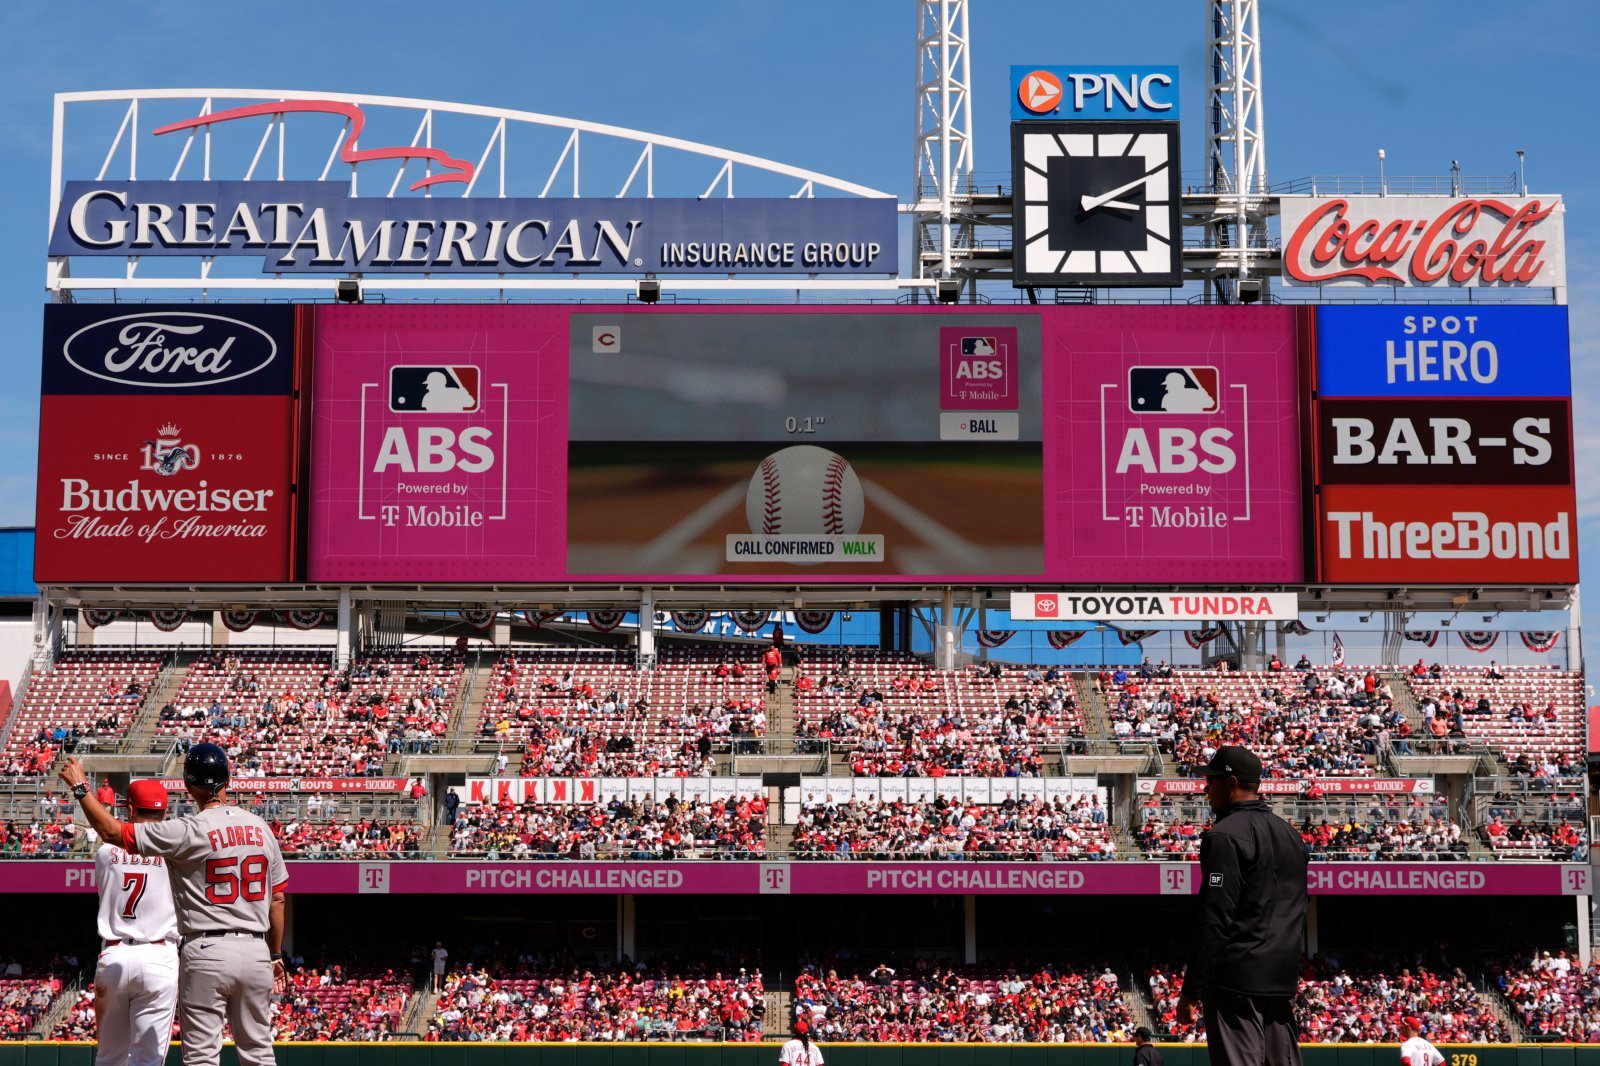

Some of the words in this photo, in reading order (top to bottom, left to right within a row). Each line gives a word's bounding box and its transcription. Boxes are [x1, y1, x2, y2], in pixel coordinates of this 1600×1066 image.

[1070, 73, 1172, 109] PNC
[70, 190, 303, 246] GREAT
[1285, 199, 1558, 284] Coca-Cola
[663, 242, 796, 264] INSURANCE
[803, 242, 881, 264] GROUP
[1403, 315, 1478, 335] SPOT
[104, 323, 237, 373] Ford
[956, 360, 1003, 379] ABS
[1387, 340, 1498, 384] HERO
[785, 416, 825, 432] 0.1"
[969, 419, 998, 433] BALL
[373, 427, 494, 474] ABS
[1116, 427, 1236, 475] ABS
[1332, 417, 1552, 466] BAR-S
[93, 453, 129, 461] SINCE
[140, 437, 201, 477] 150
[211, 453, 243, 461] 1876
[59, 478, 274, 512] Budweiser
[397, 483, 450, 493] Powered
[453, 483, 468, 496] by
[1140, 484, 1193, 494] Powered
[1196, 484, 1211, 496] by
[406, 505, 483, 527] Mobile
[1150, 506, 1228, 528] Mobile
[54, 514, 134, 540] Made
[138, 516, 167, 543] of
[160, 515, 267, 540] America
[1327, 512, 1570, 559] ThreeBond
[734, 541, 763, 555] CALL
[764, 541, 835, 555] CONFIRMED
[842, 541, 876, 555] WALK
[1068, 597, 1165, 615] TOYOTA
[1169, 596, 1273, 615] TUNDRA
[268, 781, 333, 790] STRIKEOUTS
[1275, 782, 1342, 791] STRIKOUTS
[207, 825, 264, 851] FLORES
[66, 869, 96, 887] PIT
[205, 854, 269, 905] 58
[466, 869, 532, 888] PITCH
[536, 869, 684, 888] CHALLENGED
[867, 869, 933, 889] PITCH
[937, 869, 1085, 889] CHALLENGED
[1338, 870, 1485, 890] CHALLENGED
[122, 872, 148, 919] 7
[796, 1052, 811, 1066] 44
[1451, 1053, 1478, 1066] 379
